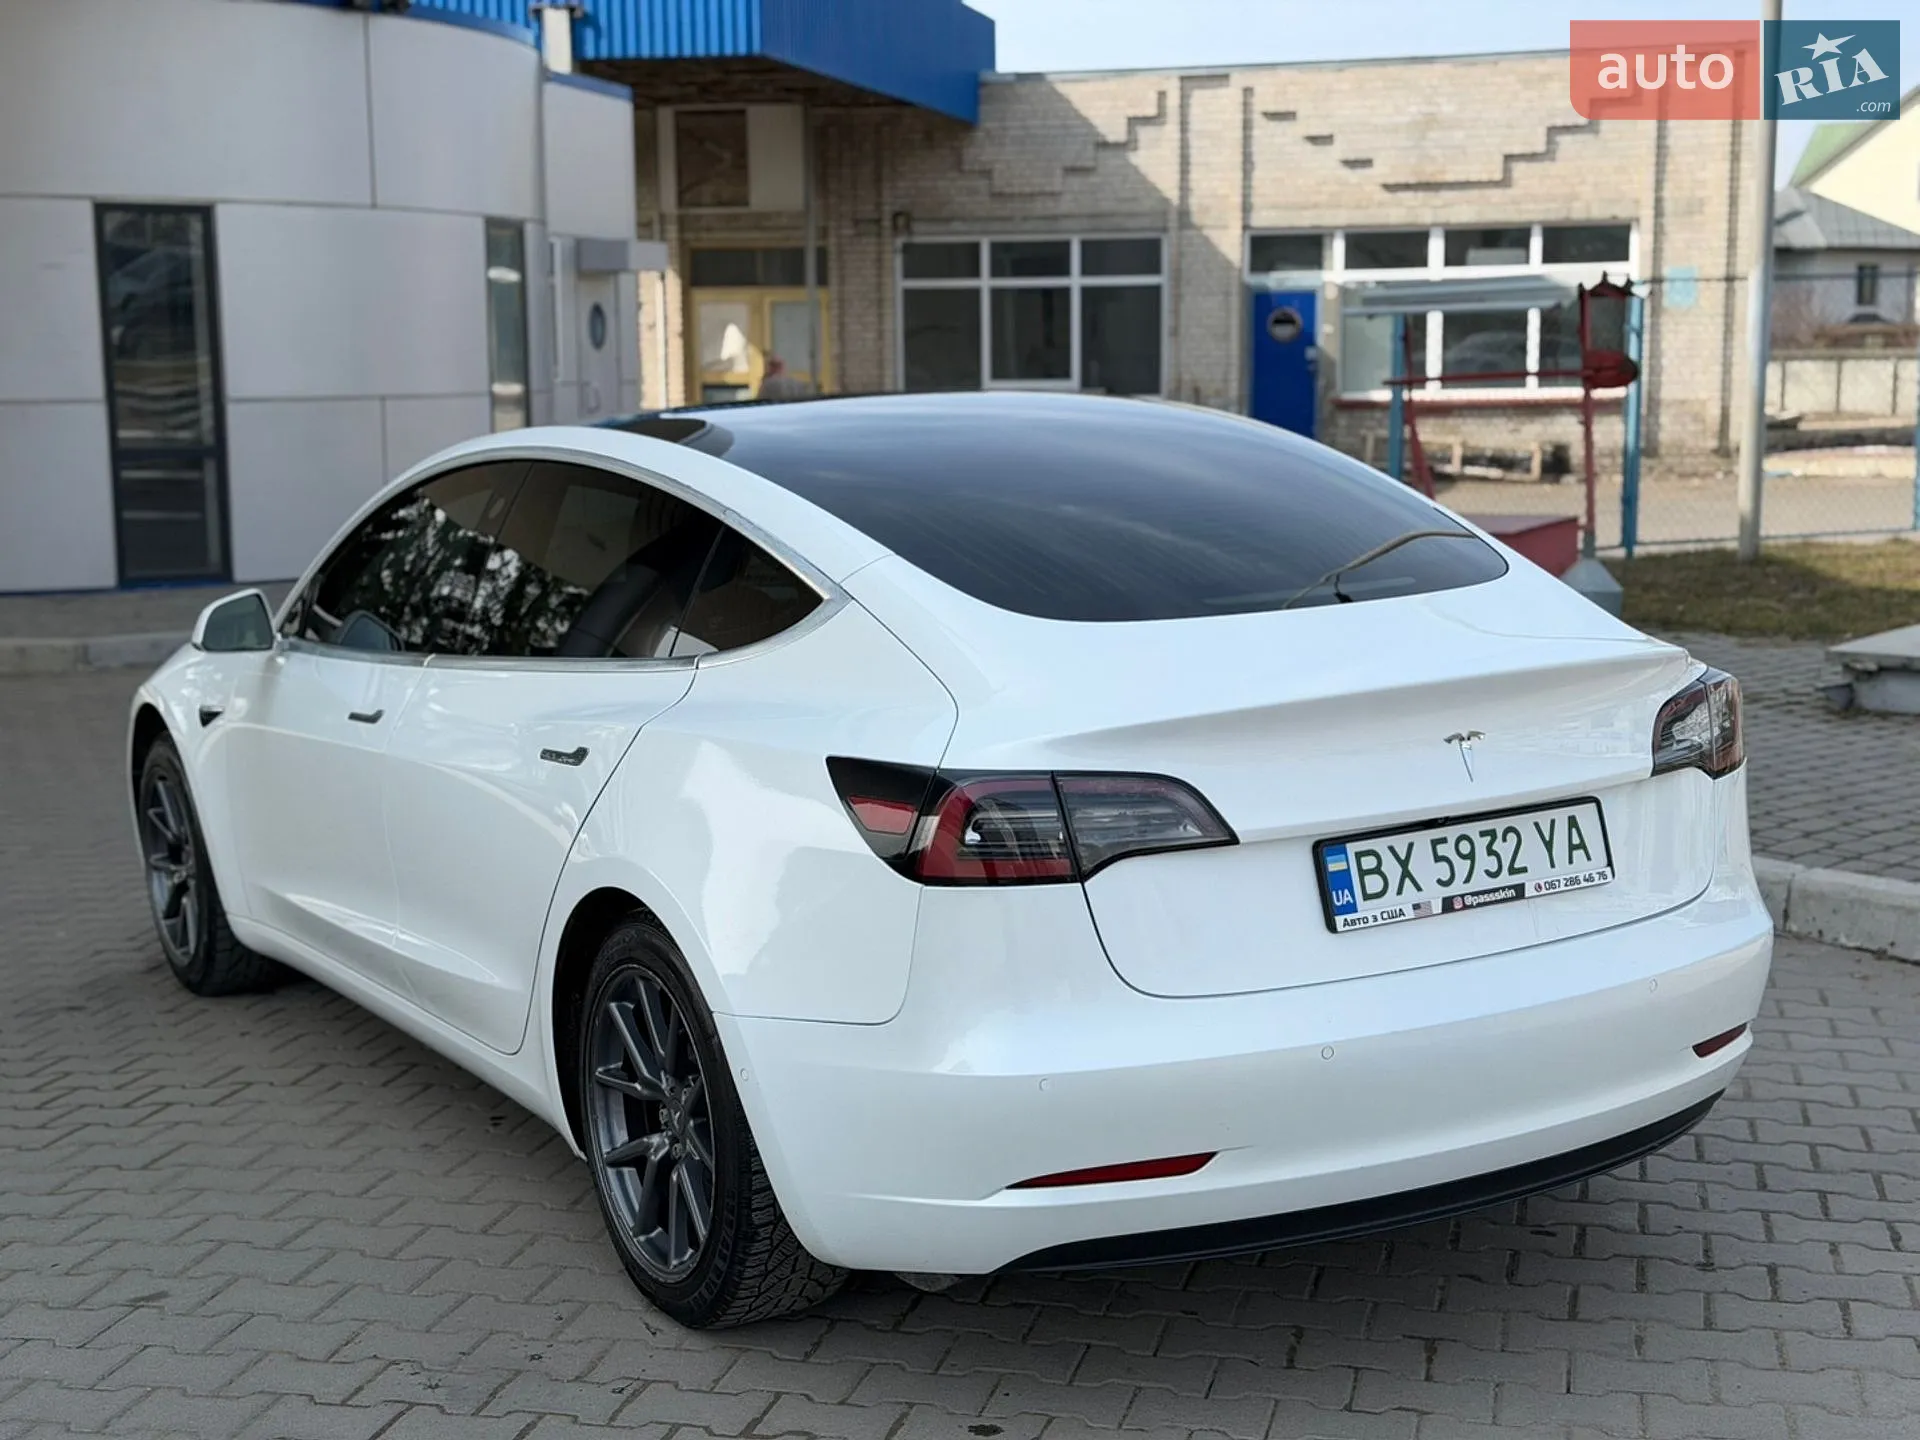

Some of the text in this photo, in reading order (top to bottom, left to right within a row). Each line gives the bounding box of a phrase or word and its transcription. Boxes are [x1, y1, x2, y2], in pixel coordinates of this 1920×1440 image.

[1354, 814, 1592, 901] BX 5932 YA
[1543, 880, 1561, 891] 067
[1583, 872, 1596, 882] 46
[1597, 871, 1608, 880] 76
[1333, 889, 1353, 906] UA
[1380, 908, 1406, 921] США
